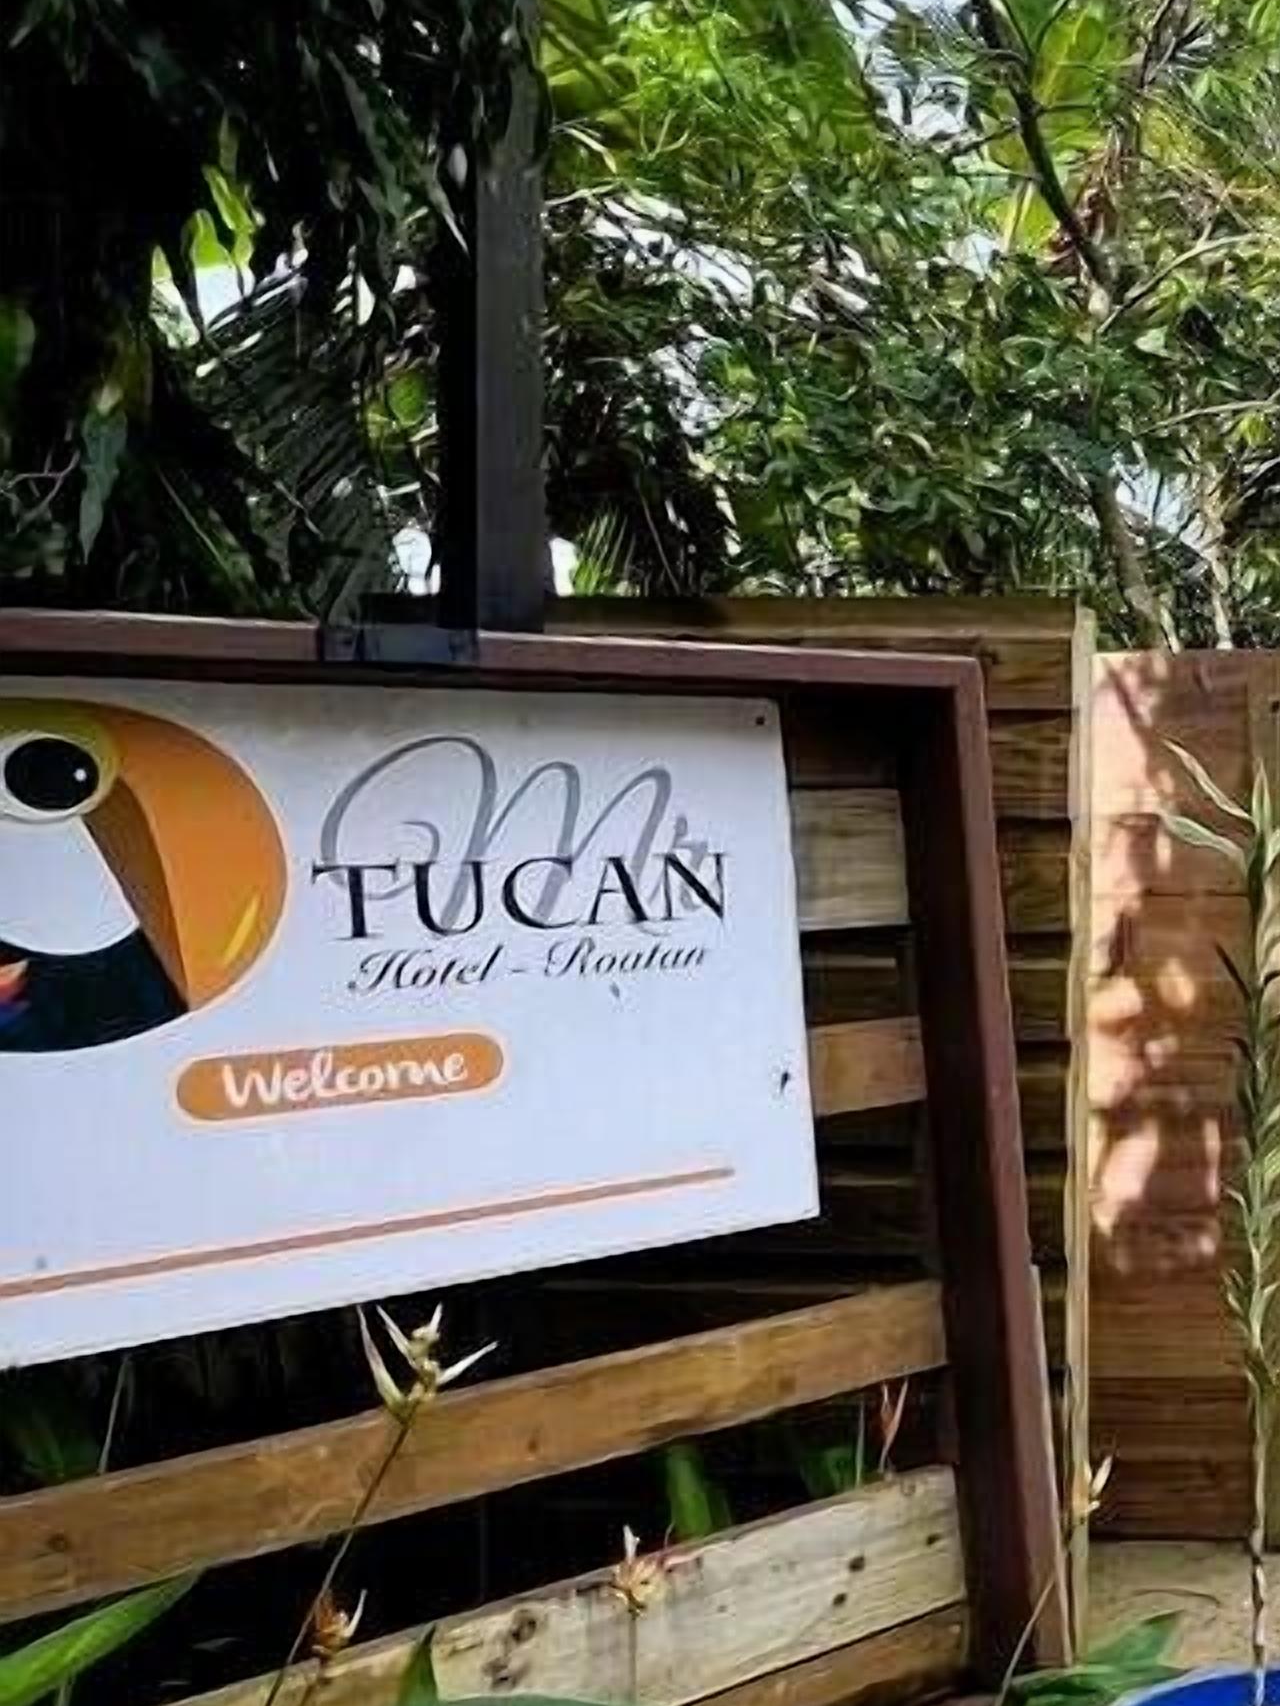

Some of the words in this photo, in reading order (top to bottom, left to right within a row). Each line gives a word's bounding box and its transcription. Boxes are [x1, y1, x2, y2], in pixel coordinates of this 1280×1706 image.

[311, 850, 733, 941] TUCAN
[347, 943, 505, 993] Hotel
[543, 936, 708, 979] Roatan
[222, 1050, 469, 1109] Welcome
